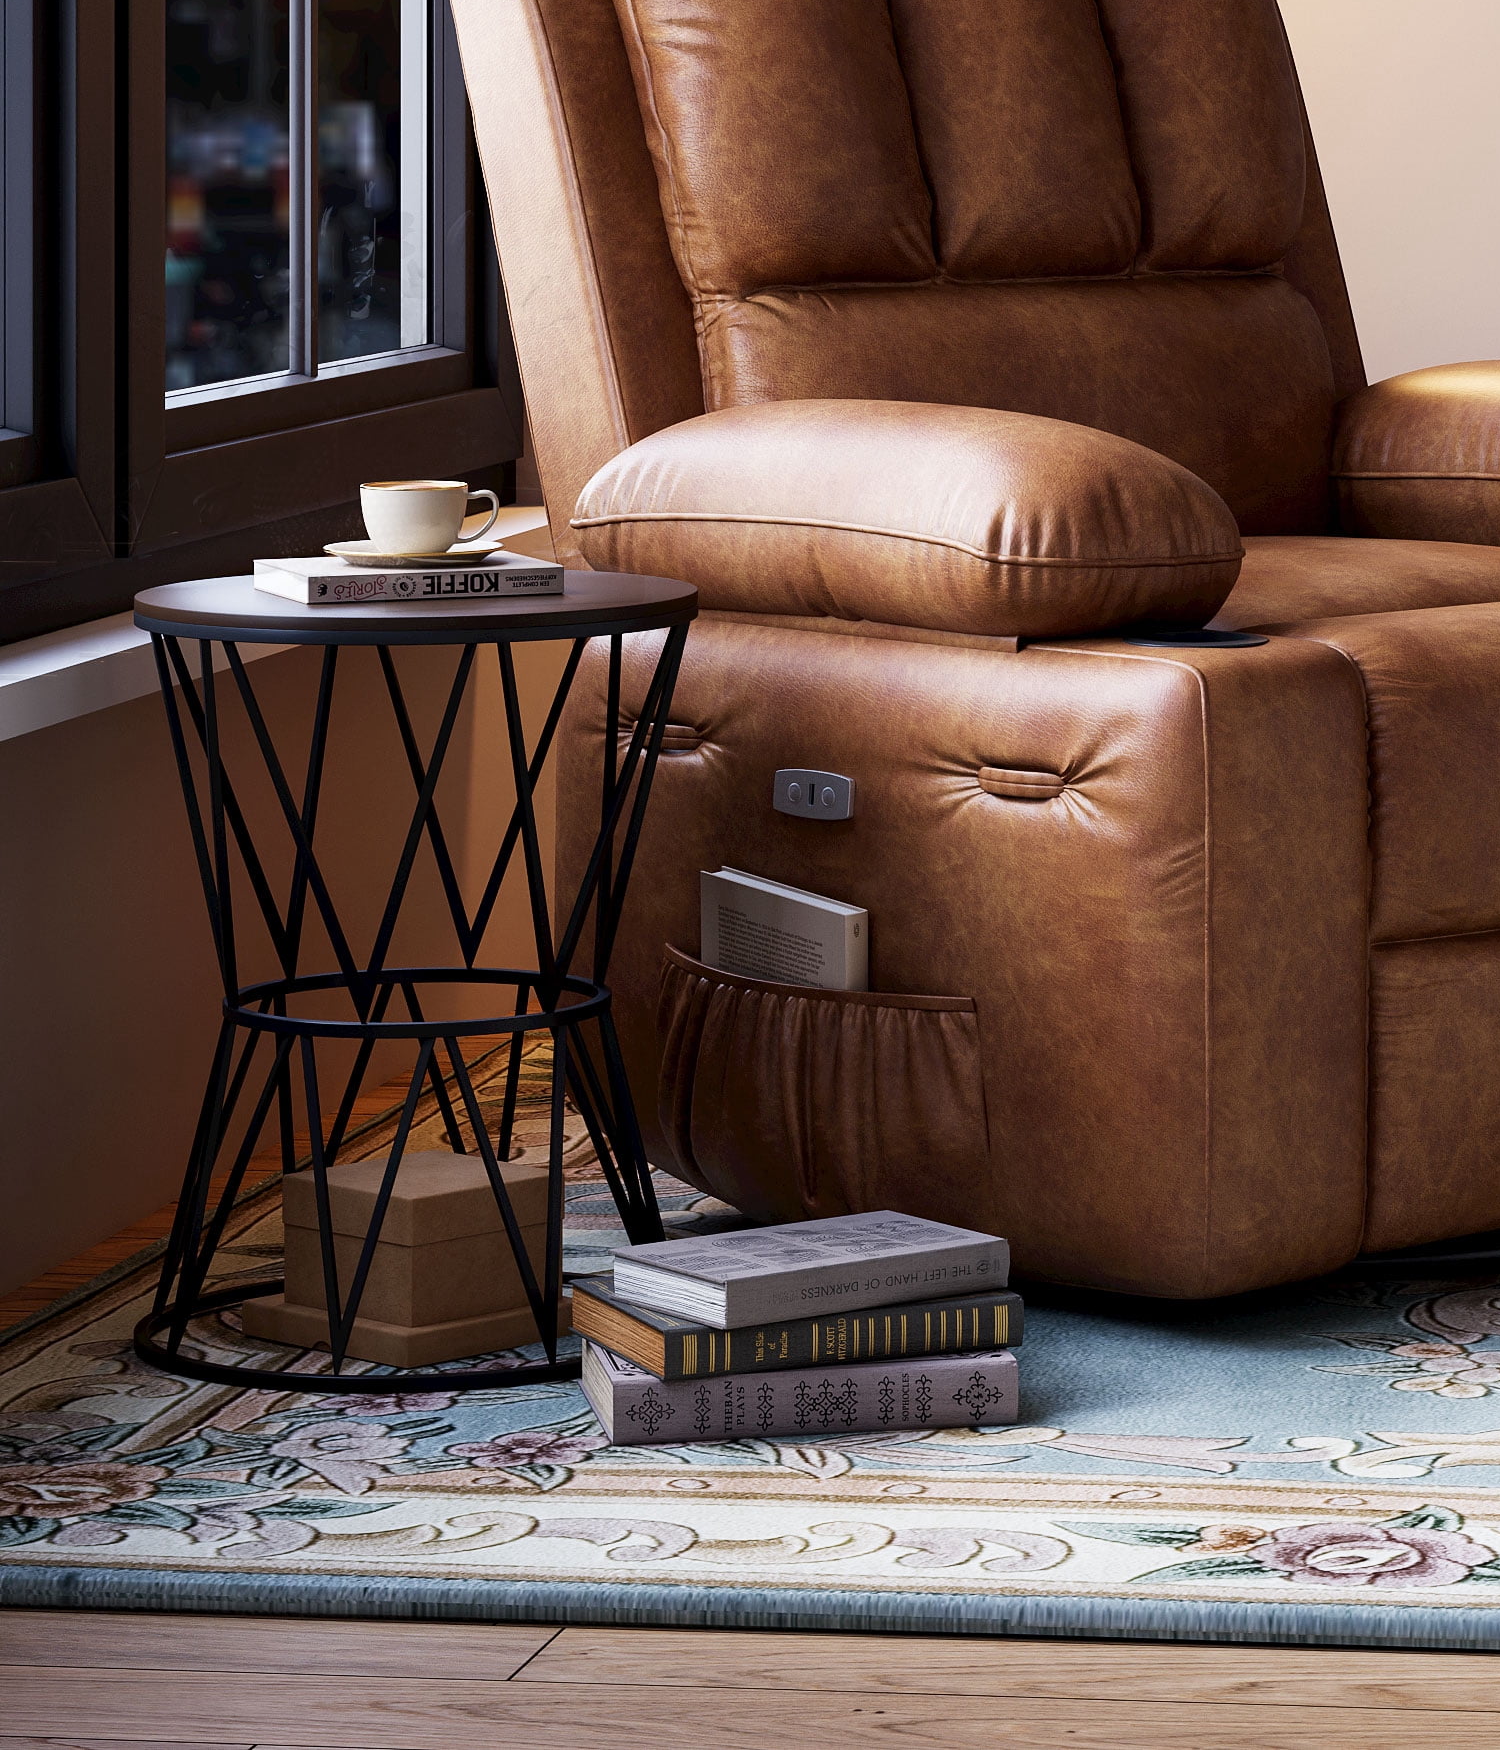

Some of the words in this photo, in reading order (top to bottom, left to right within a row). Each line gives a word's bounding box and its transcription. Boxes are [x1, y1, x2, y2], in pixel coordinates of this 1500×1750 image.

[423, 573, 499, 595] KOFFIE
[885, 1270, 919, 1286] HAND
[924, 1267, 947, 1281] LEFT
[952, 1264, 972, 1276] THE
[802, 1280, 859, 1299] DARKNESS
[864, 1277, 882, 1290] OF
[780, 1331, 788, 1360] Paradise
[838, 1318, 846, 1360] FITZGERALD
[737, 1386, 745, 1425] PLAYS
